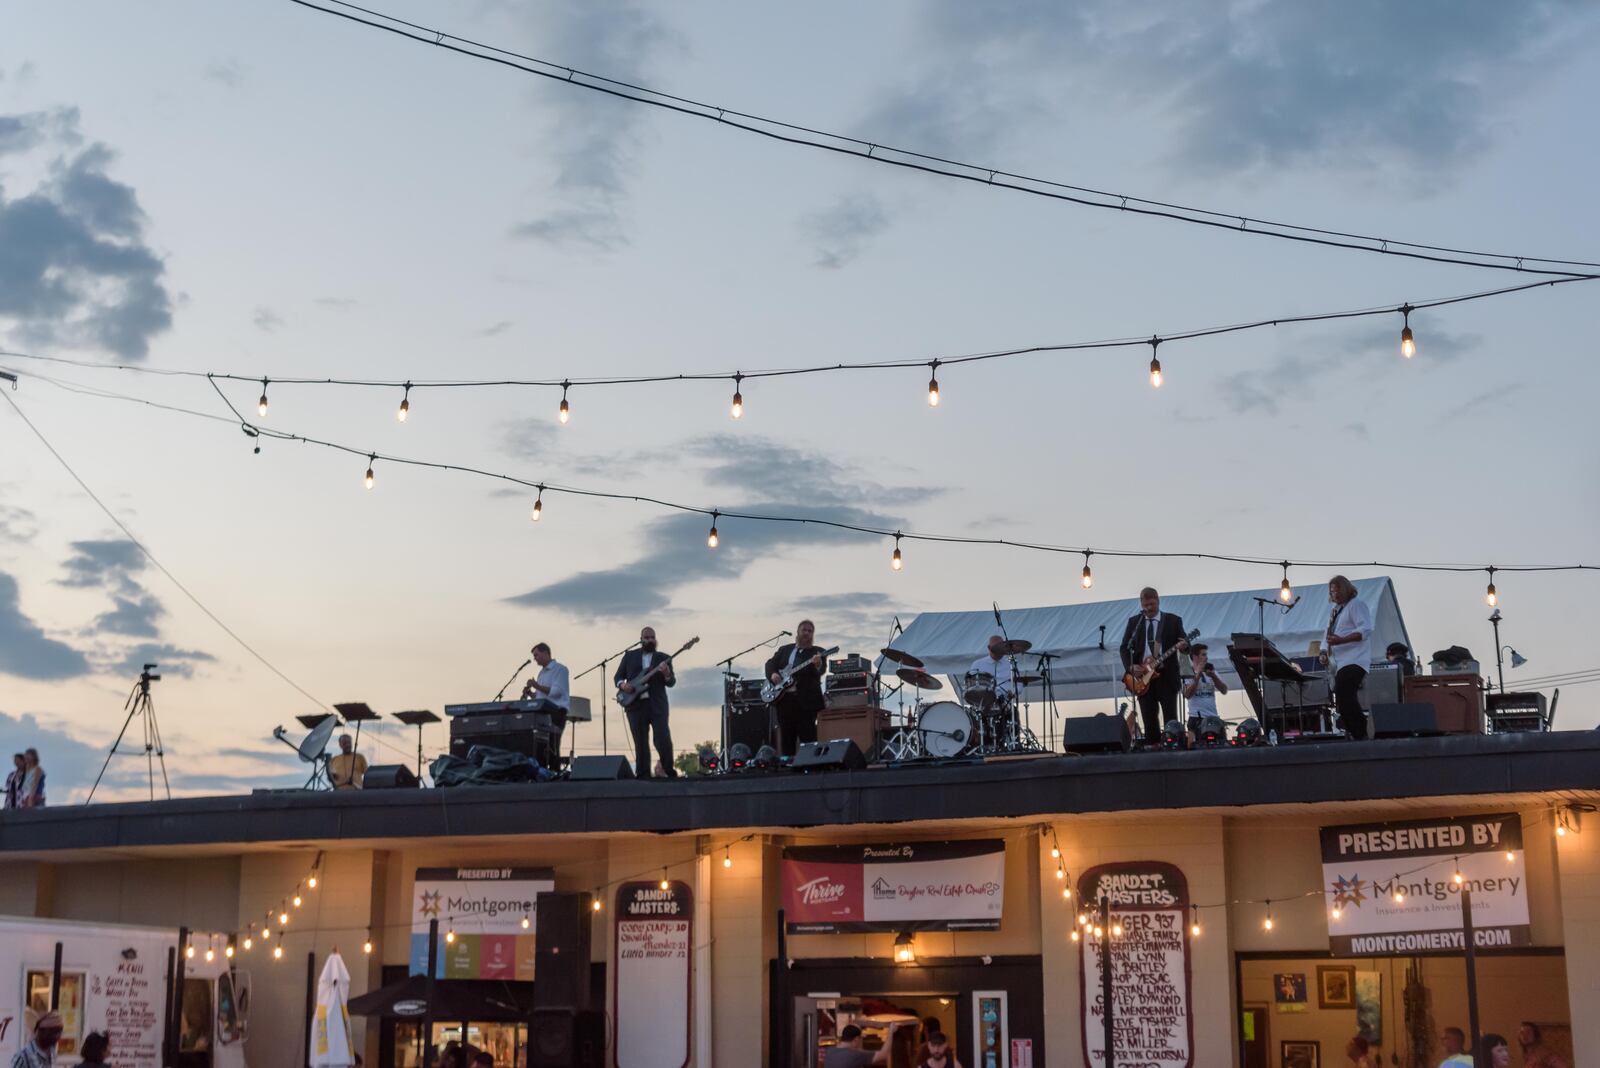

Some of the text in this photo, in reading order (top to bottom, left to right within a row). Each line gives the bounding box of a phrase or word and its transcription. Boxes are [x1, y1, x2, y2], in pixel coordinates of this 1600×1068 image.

[1338, 822, 1502, 855] PRESENTED BY
[863, 846, 914, 858] Presented By
[457, 869, 512, 879] PRESENTED BY
[1099, 874, 1163, 891] BANDIT
[1373, 876, 1521, 901] Montgomery
[637, 889, 672, 901] BANDIT
[796, 876, 845, 904] Thrive
[926, 884, 943, 896] Real
[944, 884, 964, 897] Estate
[1096, 887, 1176, 905] MASTERS
[447, 896, 538, 917] Montgomer
[630, 902, 678, 914] MASTERS
[1375, 905, 1421, 916] Insurance
[1431, 901, 1491, 912] Investents
[1154, 913, 1175, 929] 937
[1137, 952, 1165, 962] LYNN
[1121, 962, 1167, 973] BENTLEY
[1147, 985, 1177, 994] LINCK
[1095, 994, 1181, 1006] CYLEY DYMOND
[1120, 1006, 1186, 1016] MENDENHALL
[1101, 1017, 1181, 1027] EVE FISHER
[1148, 1029, 1177, 1038] LINK
[1127, 1039, 1173, 1050] MILLER
[1091, 1050, 1127, 1060] JAPER
[1145, 1049, 1187, 1061] COLOSSAL
